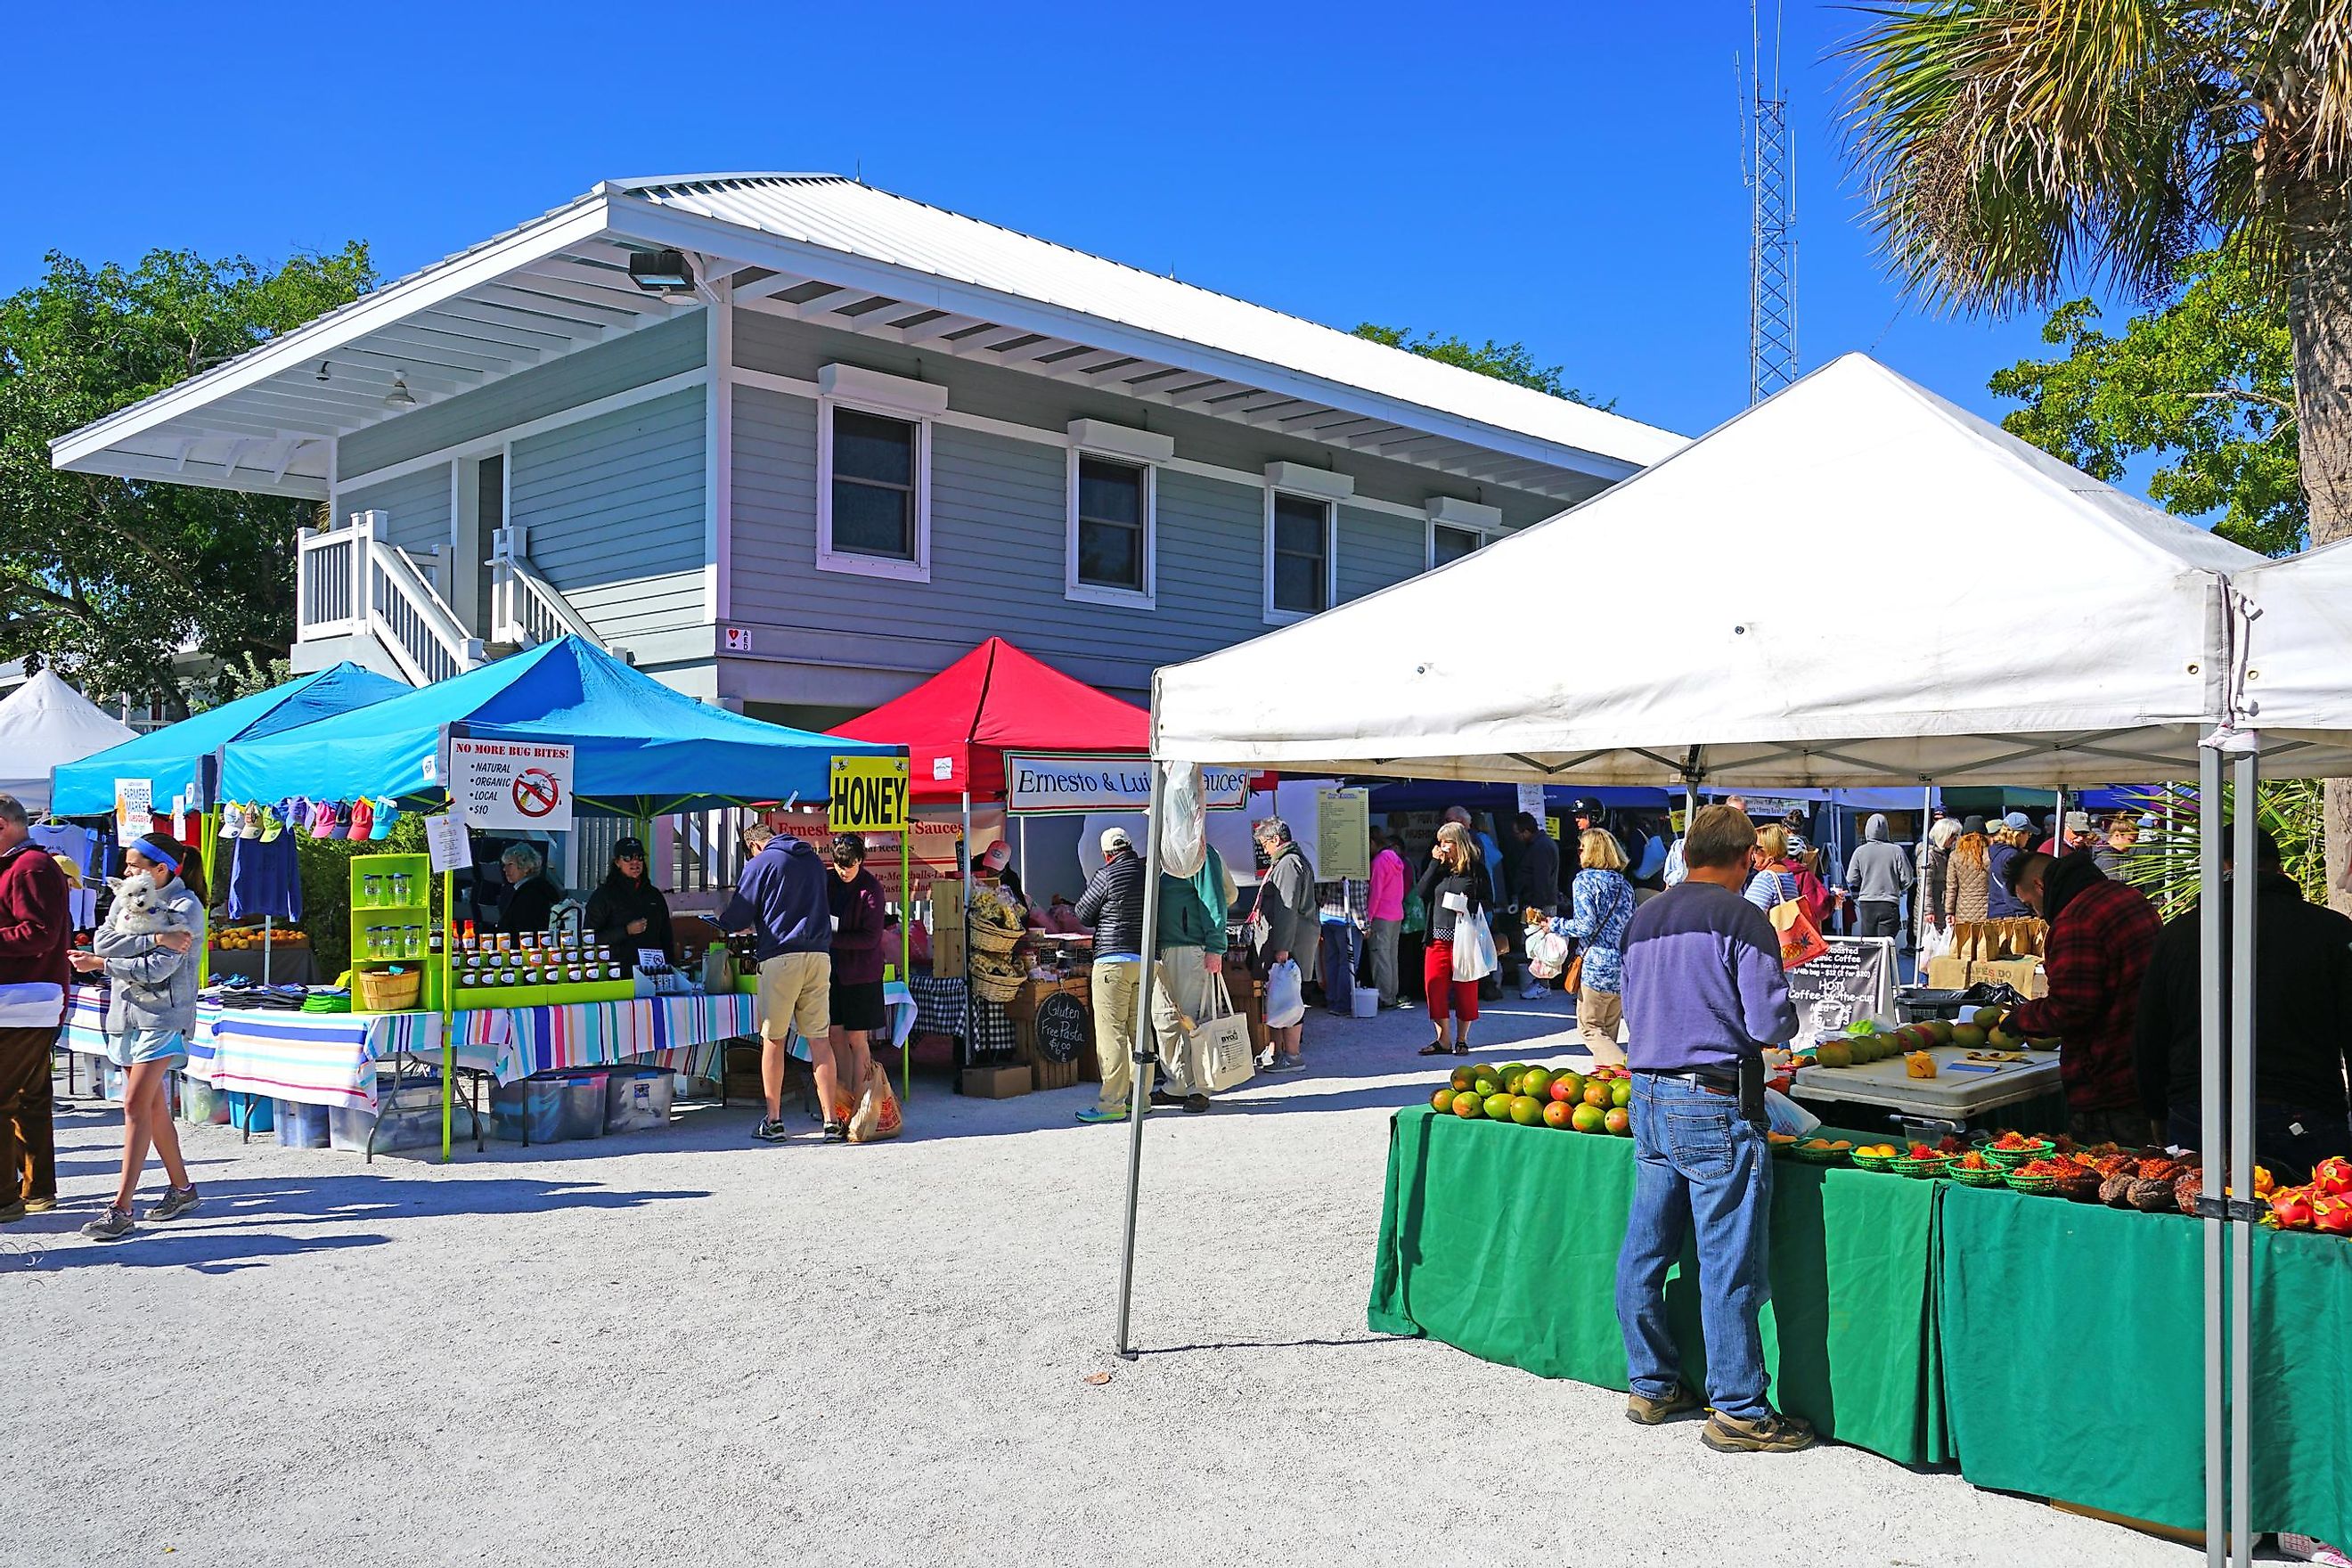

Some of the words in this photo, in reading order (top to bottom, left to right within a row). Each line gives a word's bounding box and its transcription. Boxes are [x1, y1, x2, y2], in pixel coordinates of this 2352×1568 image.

[455, 743, 472, 754] NO
[475, 744, 506, 755] MORE
[509, 746, 531, 757] BUG
[534, 747, 569, 759] BITES!
[475, 763, 511, 773] NATURAL
[475, 777, 511, 788] ORGANIC
[1017, 770, 1098, 793] Ernesto
[1103, 772, 1115, 790] &
[125, 788, 150, 801] FARMERS
[475, 790, 498, 801] LOCAL
[833, 776, 907, 826] HONEY
[474, 804, 489, 815] $10
[778, 821, 837, 837] Ernest
[1833, 954, 1862, 963] Coffee
[1997, 969, 2012, 978] DO
[1048, 999, 1080, 1020] Gluten
[1041, 1017, 1059, 1037] Free
[1060, 1021, 1085, 1042] Pasta
